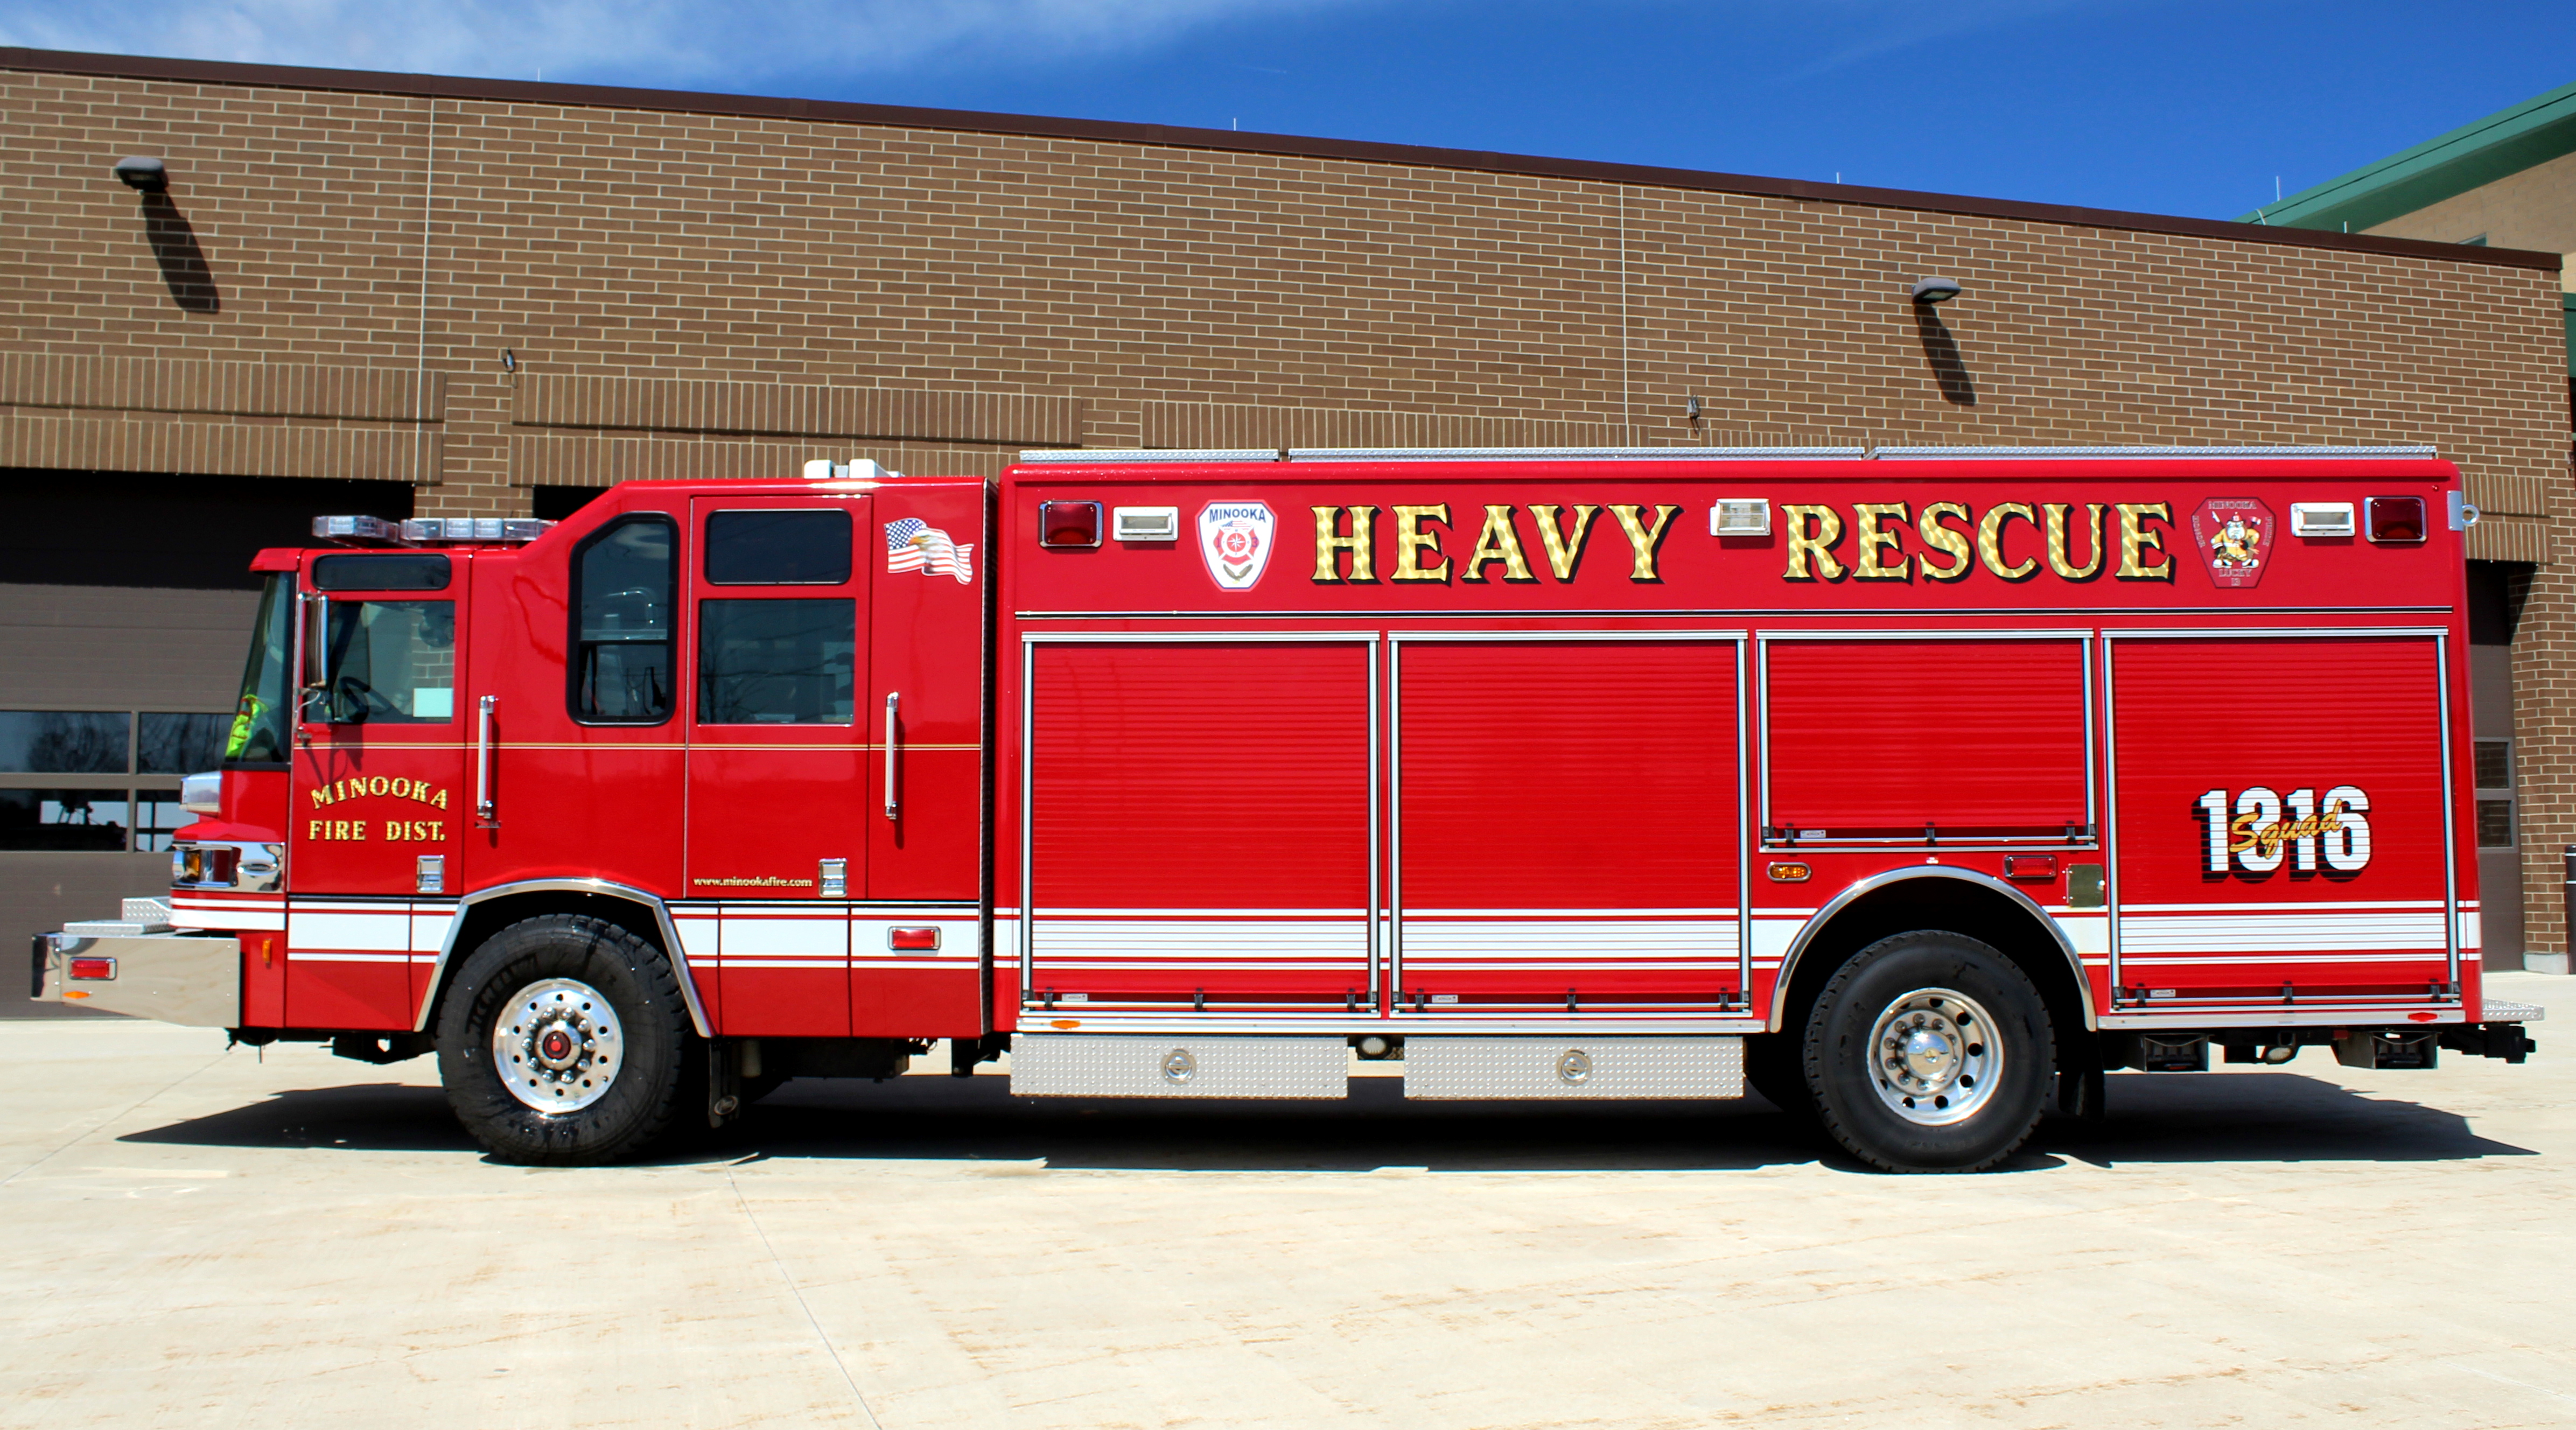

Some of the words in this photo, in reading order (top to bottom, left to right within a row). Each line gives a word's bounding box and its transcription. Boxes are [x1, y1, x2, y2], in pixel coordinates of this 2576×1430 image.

[1209, 508, 1266, 523] MINOOKA
[2208, 501, 2257, 509] MINOOKA
[1310, 502, 1681, 585] HEAVY
[1780, 501, 2174, 585] RESCUE
[2218, 569, 2252, 577] LUCKY
[310, 776, 447, 811] MINOOKA
[309, 820, 366, 840] FIRE
[385, 821, 446, 841] DIST.
[2194, 785, 2371, 881] 1316
[2229, 798, 2342, 859] Squad
[693, 876, 813, 887] www.minookafire.com
